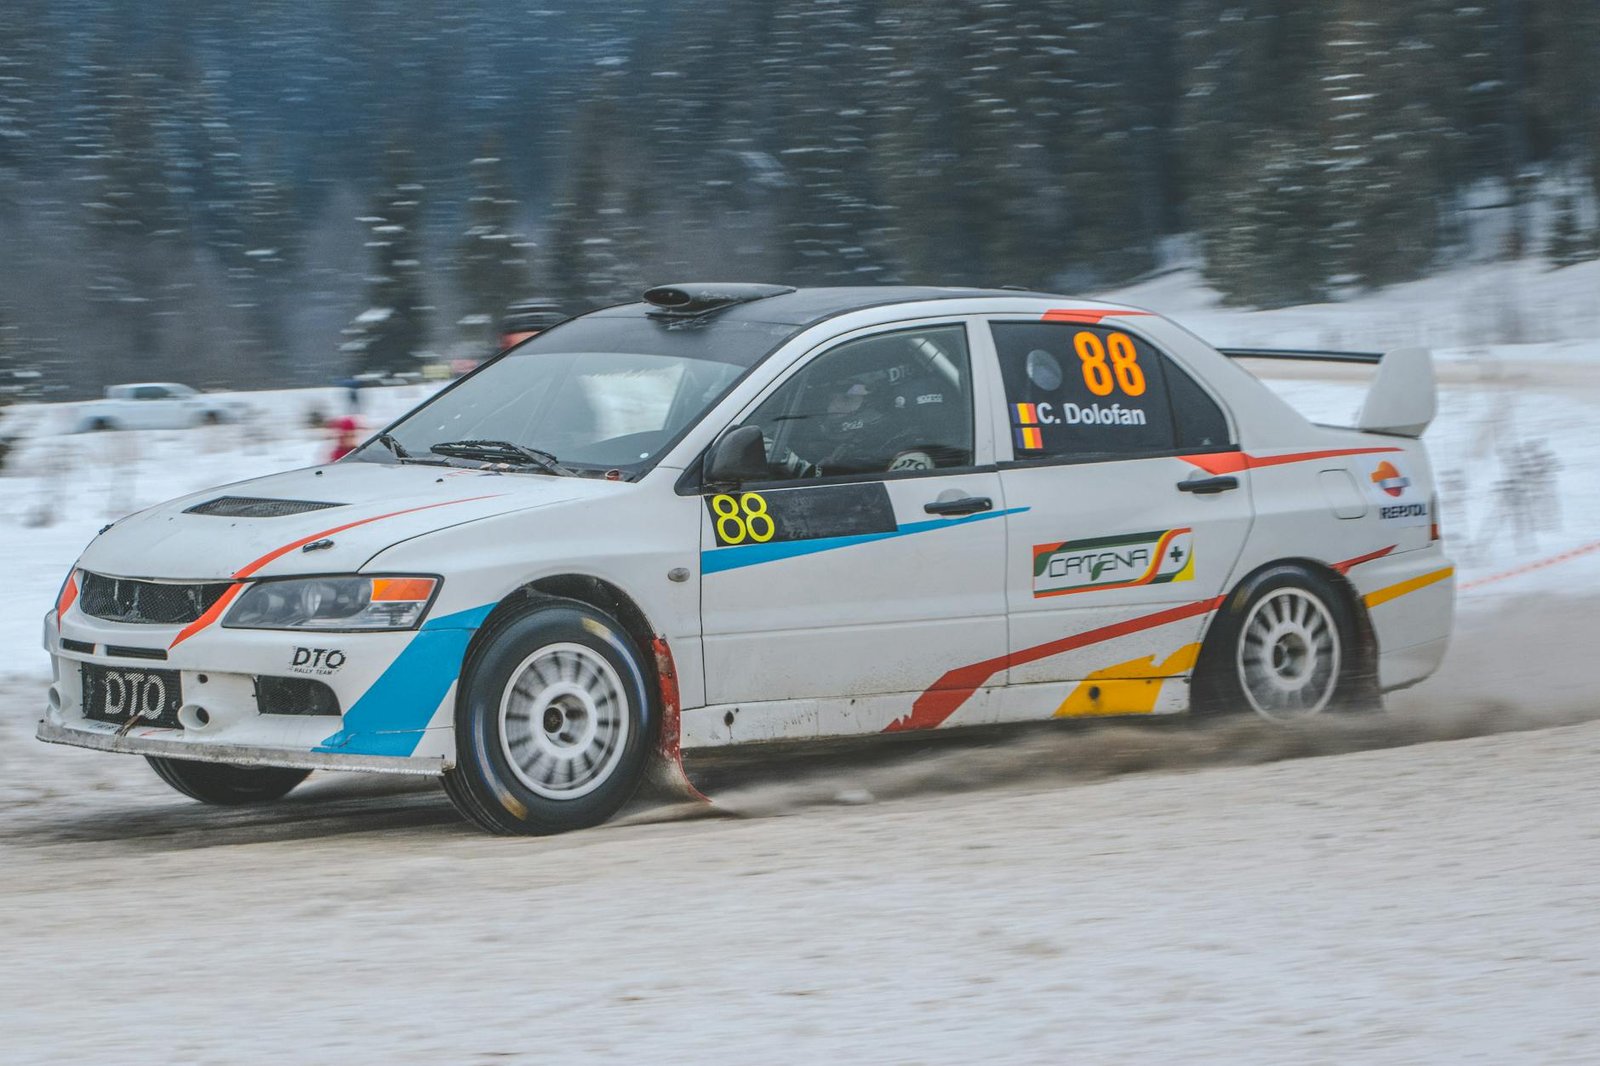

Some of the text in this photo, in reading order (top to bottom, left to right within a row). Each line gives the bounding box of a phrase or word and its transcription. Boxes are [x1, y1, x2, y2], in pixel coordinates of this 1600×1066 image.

[1073, 331, 1146, 396] 88
[1037, 402, 1147, 425] C. Dolofan
[712, 492, 775, 544] 88
[1049, 549, 1149, 579] CATENA
[292, 646, 346, 669] DTO
[104, 671, 165, 720] DTO
